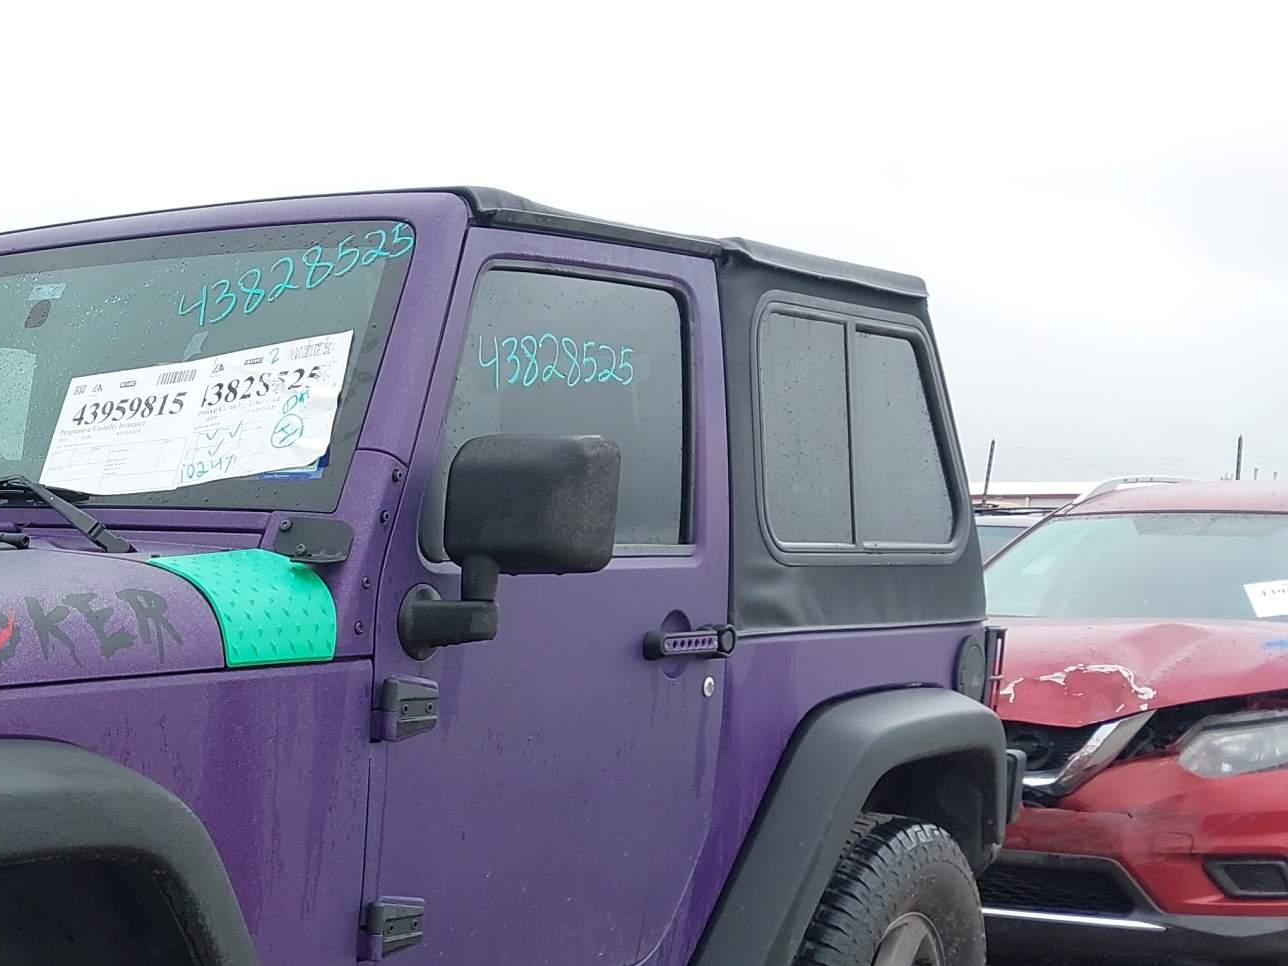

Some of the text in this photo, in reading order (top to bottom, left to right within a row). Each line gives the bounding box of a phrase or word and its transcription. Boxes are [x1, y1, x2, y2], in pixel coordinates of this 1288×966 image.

[178, 221, 415, 326] 43828525
[479, 333, 635, 392] 43828525
[72, 391, 188, 426] 43959815
